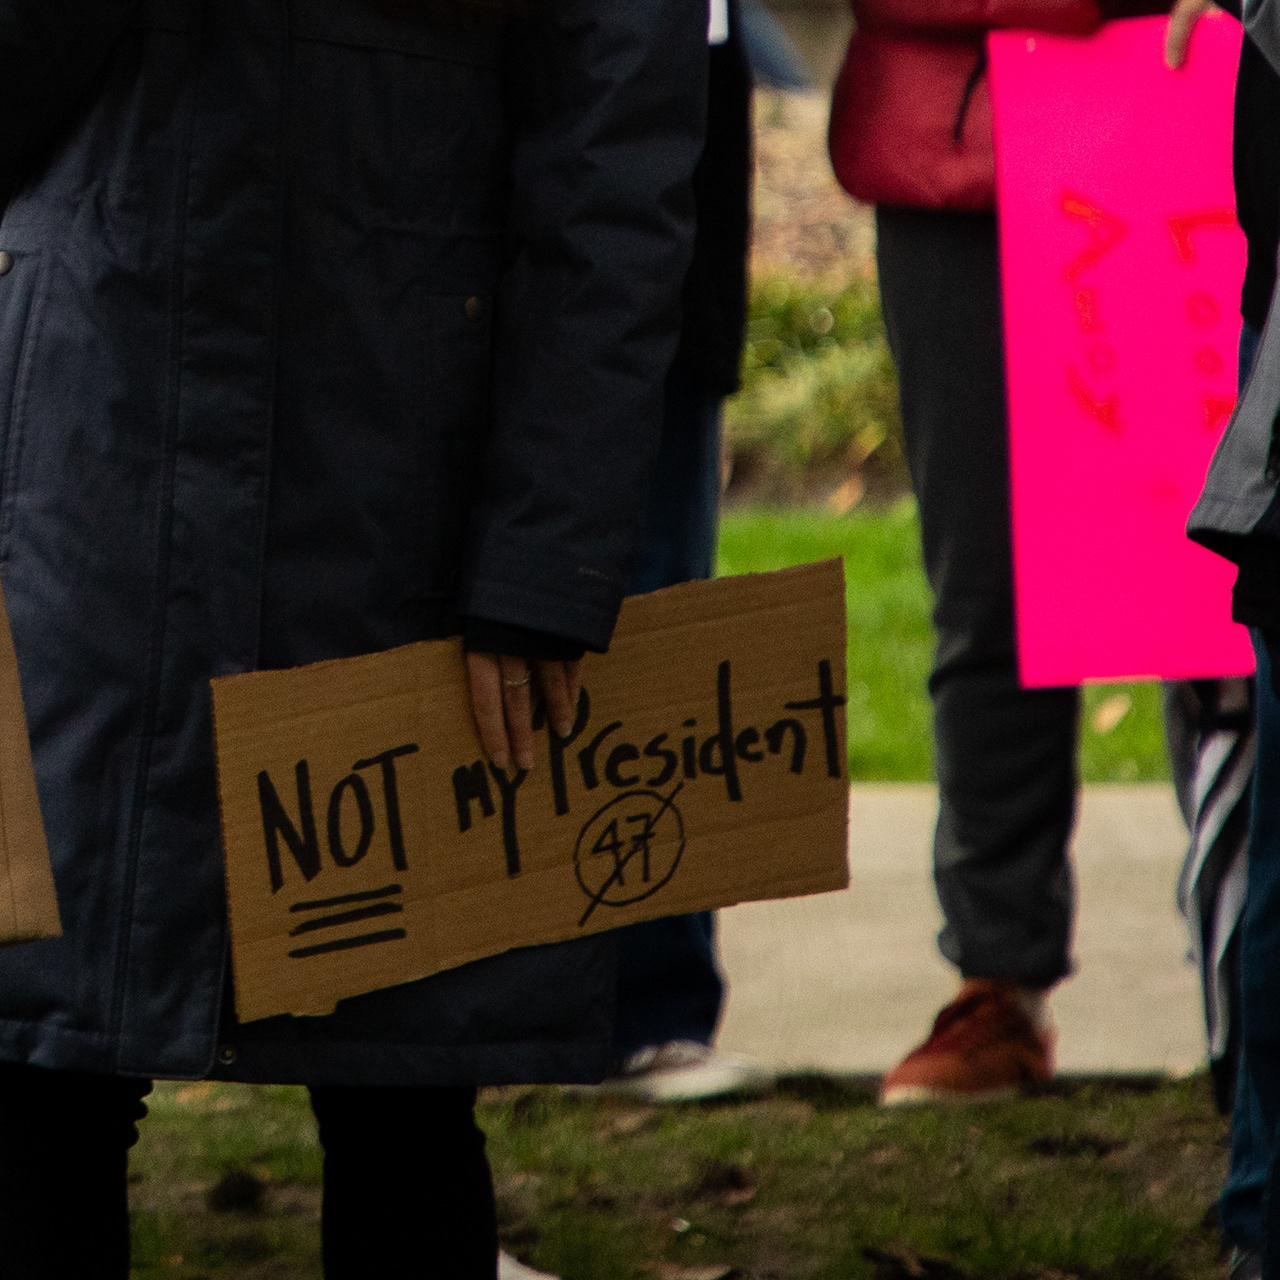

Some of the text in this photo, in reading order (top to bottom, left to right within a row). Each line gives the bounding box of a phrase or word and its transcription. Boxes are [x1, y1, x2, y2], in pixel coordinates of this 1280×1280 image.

[256, 742, 419, 894] NOT
[533, 658, 847, 817] President
[591, 810, 656, 887] 47
